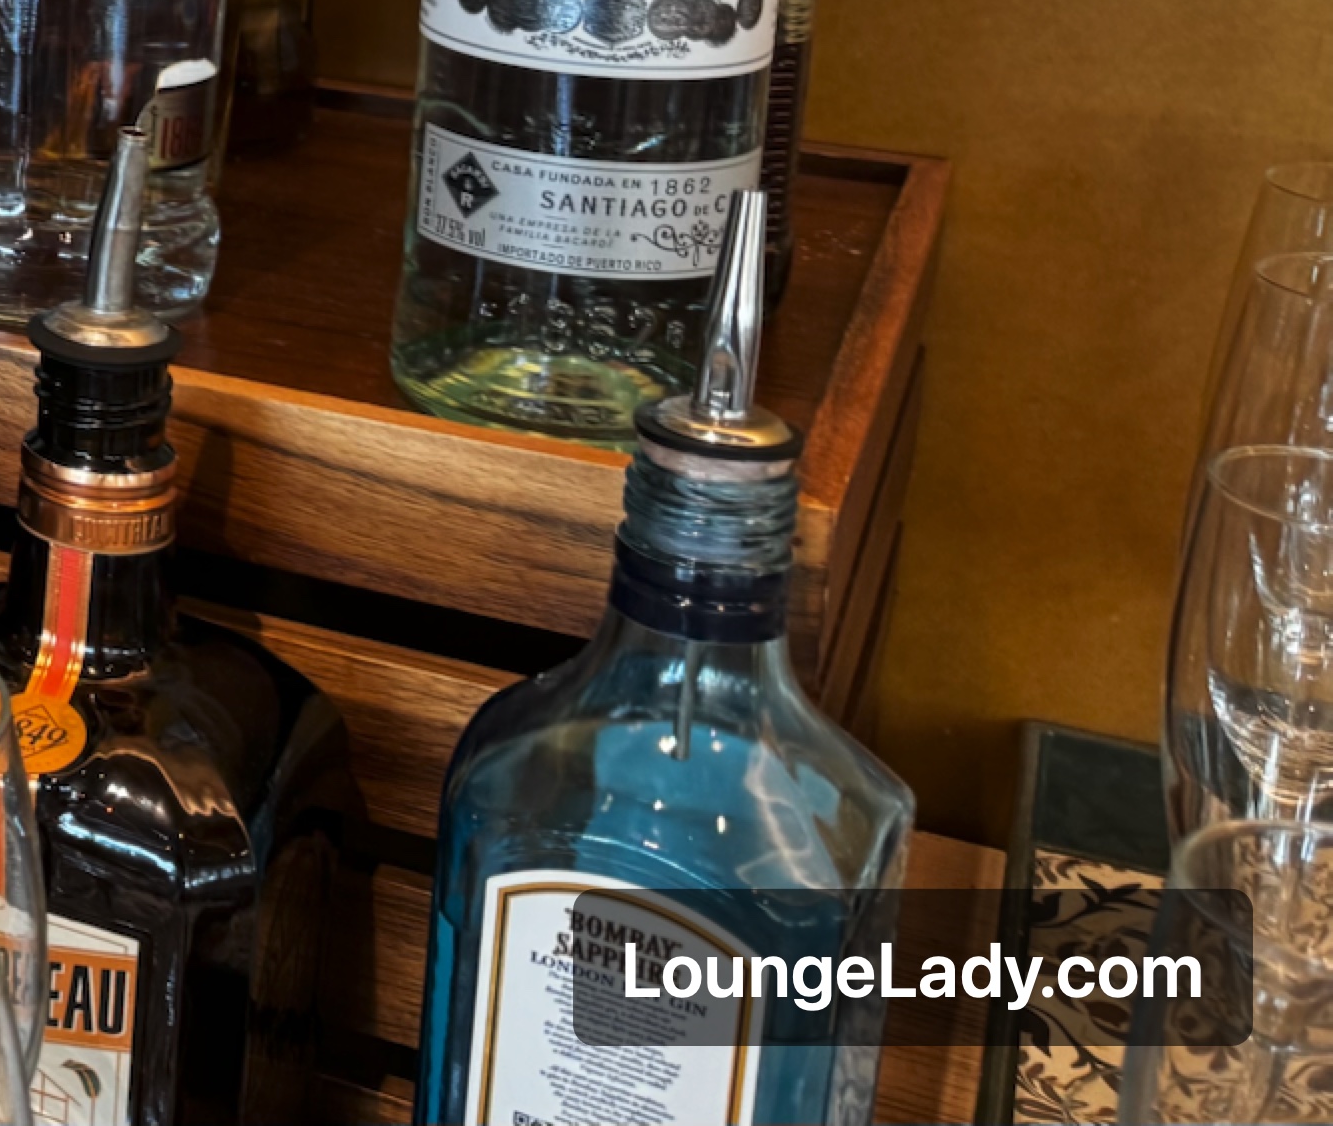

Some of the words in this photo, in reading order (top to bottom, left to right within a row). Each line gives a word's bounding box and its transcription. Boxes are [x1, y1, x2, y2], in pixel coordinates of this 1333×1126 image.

[490, 159, 534, 178] CASA
[539, 168, 617, 189] FUNDADA
[622, 179, 643, 190] EN
[650, 176, 713, 197] 1862
[540, 190, 688, 219] SANTIAGO
[694, 204, 710, 217] DE
[498, 243, 566, 267] IMPORTADO
[586, 257, 632, 271] PUERTO
[567, 908, 679, 962] BOMBAY
[530, 950, 615, 989] LONDON
